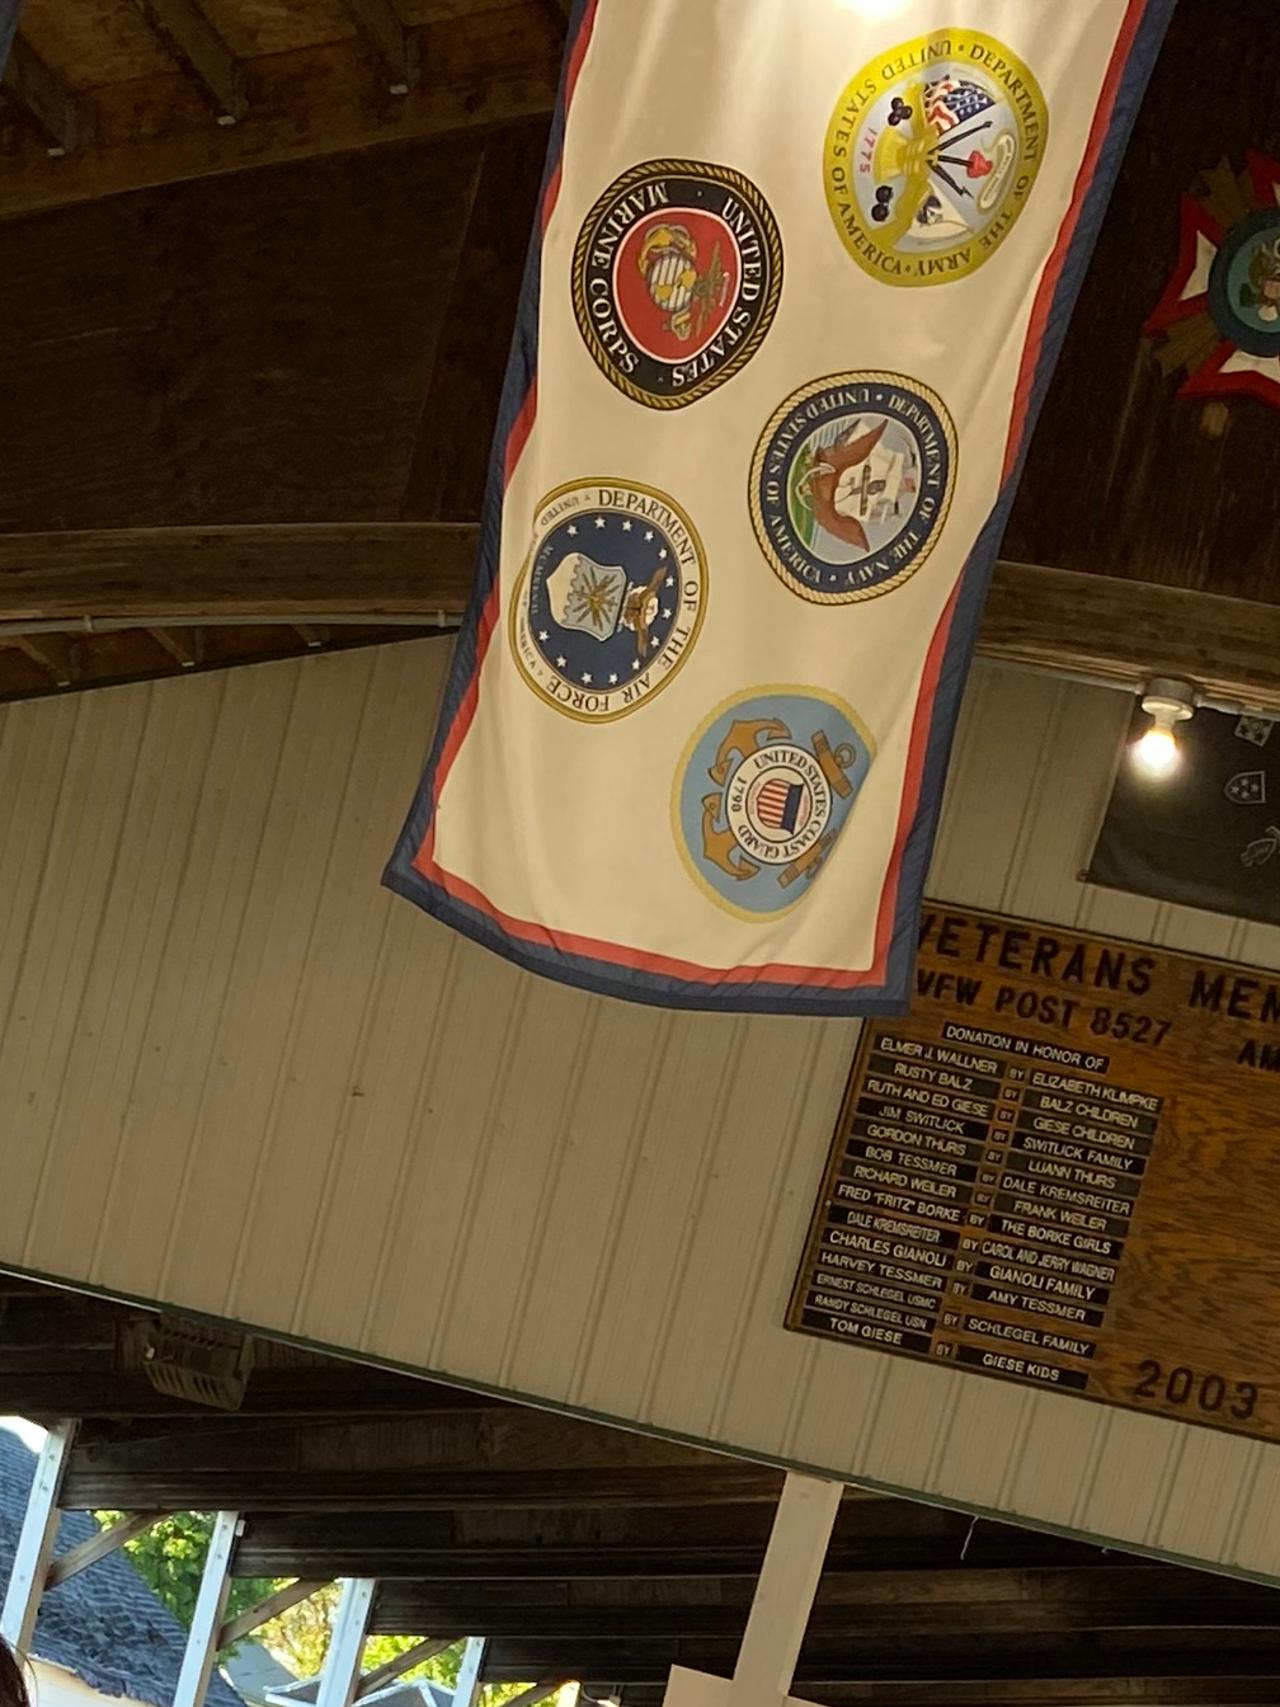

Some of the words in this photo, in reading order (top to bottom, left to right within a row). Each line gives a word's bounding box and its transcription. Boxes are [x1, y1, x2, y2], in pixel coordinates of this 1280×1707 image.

[881, 40, 952, 81] UNITED
[832, 80, 877, 158] STATES
[969, 44, 1042, 161] DEPARTMENT
[831, 167, 848, 195] OF
[591, 181, 670, 270] MARINE
[836, 202, 903, 276] AMERICA
[721, 197, 762, 301] UNITED
[915, 249, 972, 276] ARMY
[589, 278, 640, 374] CORPS
[671, 307, 752, 387] STATES
[598, 489, 697, 566] DEPARTMENT
[682, 580, 699, 613] OF
[657, 625, 690, 670] THE
[546, 676, 610, 712] FORCE
[622, 673, 652, 705] AIR
[752, 750, 808, 769] UNITED
[731, 777, 747, 812] 1790
[805, 764, 828, 818] STATES
[782, 820, 822, 858] COAST
[916, 968, 982, 1006] VFW
[995, 985, 1081, 1029] POST
[1090, 1006, 1173, 1046] 8527
[880, 1037, 922, 1057] ELMER
[937, 1049, 998, 1074] WALLNER
[945, 1025, 1012, 1050] DONATION
[1015, 1039, 1029, 1054] IN
[1032, 1042, 1082, 1068] HONOR
[1084, 1055, 1105, 1071] OF
[894, 1062, 937, 1082] RUSTY
[938, 1072, 973, 1091] BALZ
[1032, 1072, 1101, 1097] ELIZABETH
[867, 1079, 902, 1097] RUTH
[903, 1088, 930, 1103] AND
[932, 1094, 950, 1108] ED
[951, 1099, 990, 1117] GIESE
[879, 1106, 901, 1120] JIM
[1040, 1096, 1074, 1113] BALZ
[1076, 1103, 1138, 1129] CHILDREN
[867, 1124, 922, 1146] GORDON
[925, 1136, 967, 1157] THURS
[1033, 1117, 1070, 1135] GIESE
[1072, 1125, 1135, 1150] CHILDREN
[853, 1165, 908, 1187] RICHARD
[866, 1146, 893, 1162] BOB
[899, 1152, 958, 1176] TESSMER
[1028, 1160, 1070, 1179] LUANN
[1075, 1169, 1117, 1190] THURS
[1087, 1150, 1134, 1171] FAMILY
[837, 1185, 871, 1201] FRED
[917, 1202, 961, 1222] BORKE
[1002, 1176, 1037, 1194] DALE
[1039, 1184, 1130, 1215] KREMSREITER
[1013, 1201, 1058, 1220] FRANK
[846, 1211, 872, 1228] DALE
[830, 1231, 890, 1255] CHARLES
[893, 1245, 947, 1267] GIANOLI
[1001, 1220, 1026, 1235] THE
[1028, 1226, 1072, 1246] BORKE
[1073, 1236, 1112, 1255] GIRLS
[822, 1252, 876, 1270] HARVEY
[879, 1264, 942, 1289] TESSMER
[982, 1242, 1014, 1260] CAROL
[1016, 1249, 1038, 1265] AND
[1038, 1255, 1071, 1272] JERRY
[1071, 1261, 1115, 1281] WAGNER
[990, 1265, 1043, 1289] GIANOLI
[1045, 1278, 1095, 1300] FAMILY
[850, 1302, 902, 1323] SCHLEGEL
[988, 1290, 1019, 1305] AMY
[1021, 1297, 1086, 1321] TESSMER
[830, 1318, 860, 1333] TOM
[862, 1325, 903, 1345] GIESE
[968, 1319, 1040, 1345] SCHLEGEL
[1042, 1335, 1090, 1355] FAMILY
[982, 1353, 1025, 1373] GIESE
[1027, 1363, 1060, 1382] KIDS
[1133, 1359, 1258, 1419] 2003
